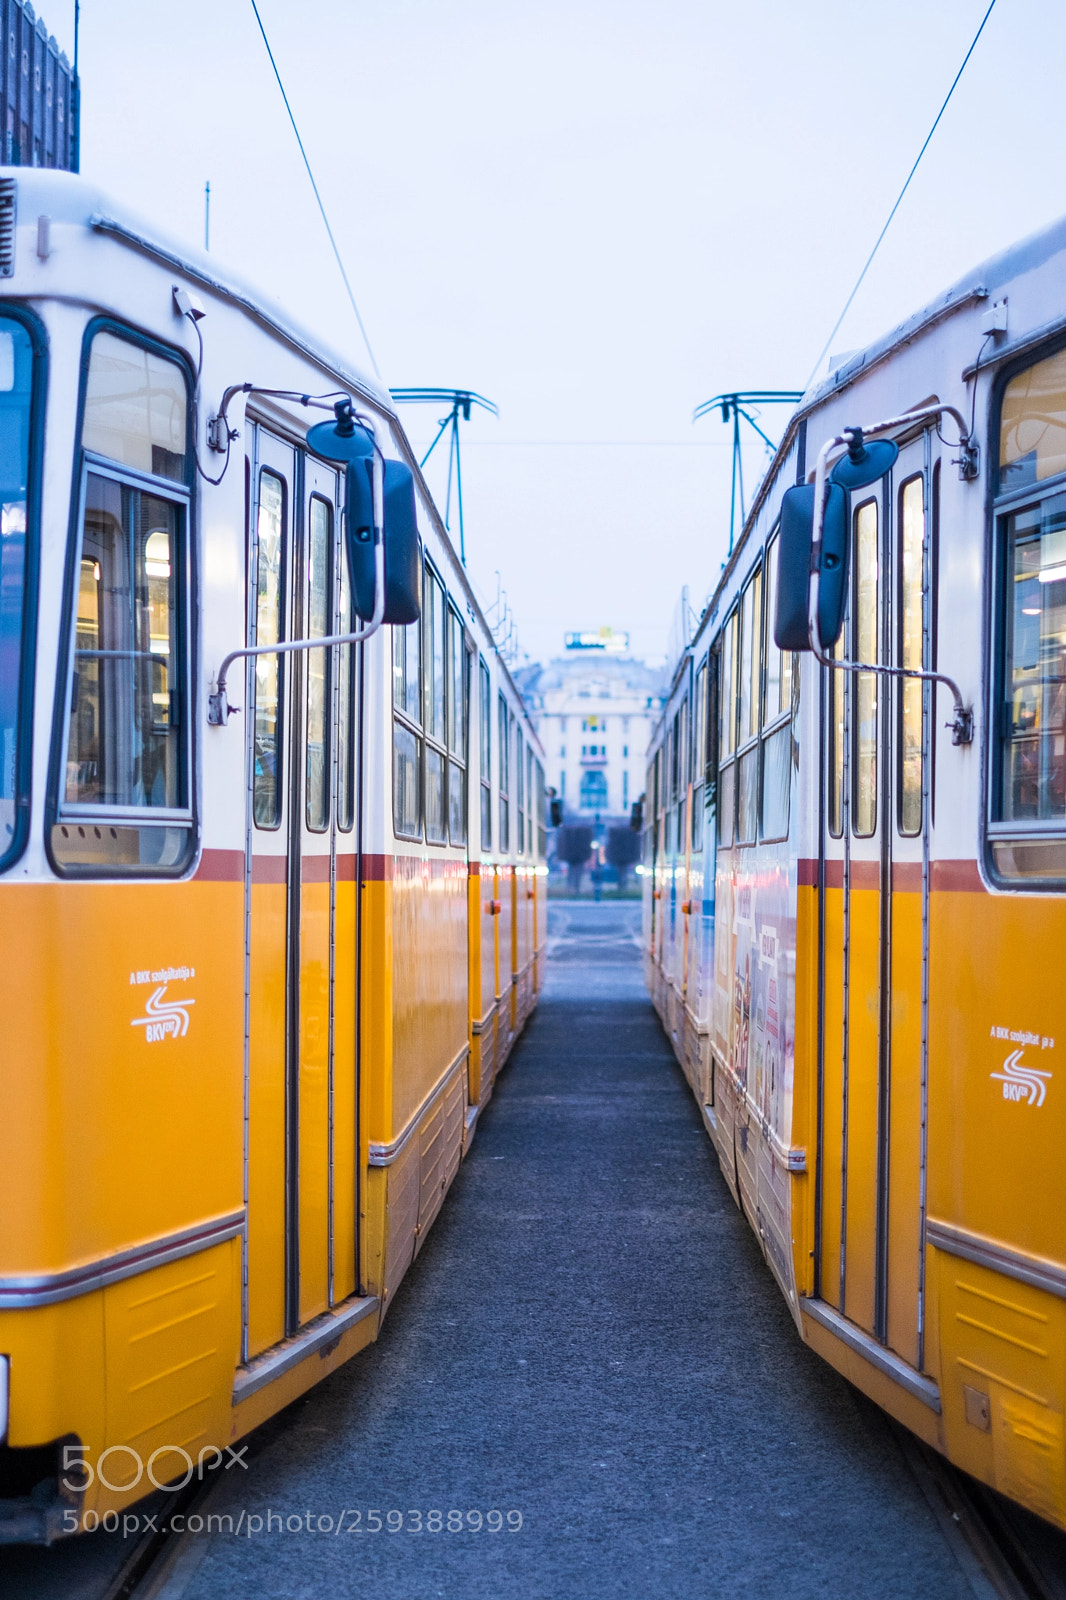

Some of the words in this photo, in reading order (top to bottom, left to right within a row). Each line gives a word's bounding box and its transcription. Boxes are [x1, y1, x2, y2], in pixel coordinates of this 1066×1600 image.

[130, 972, 136, 985] A
[136, 970, 151, 984] BKK
[146, 1022, 165, 1043] BKV
[990, 1026, 996, 1037] A
[996, 1026, 1009, 1039] BKK
[1003, 1082, 1021, 1102] BKV
